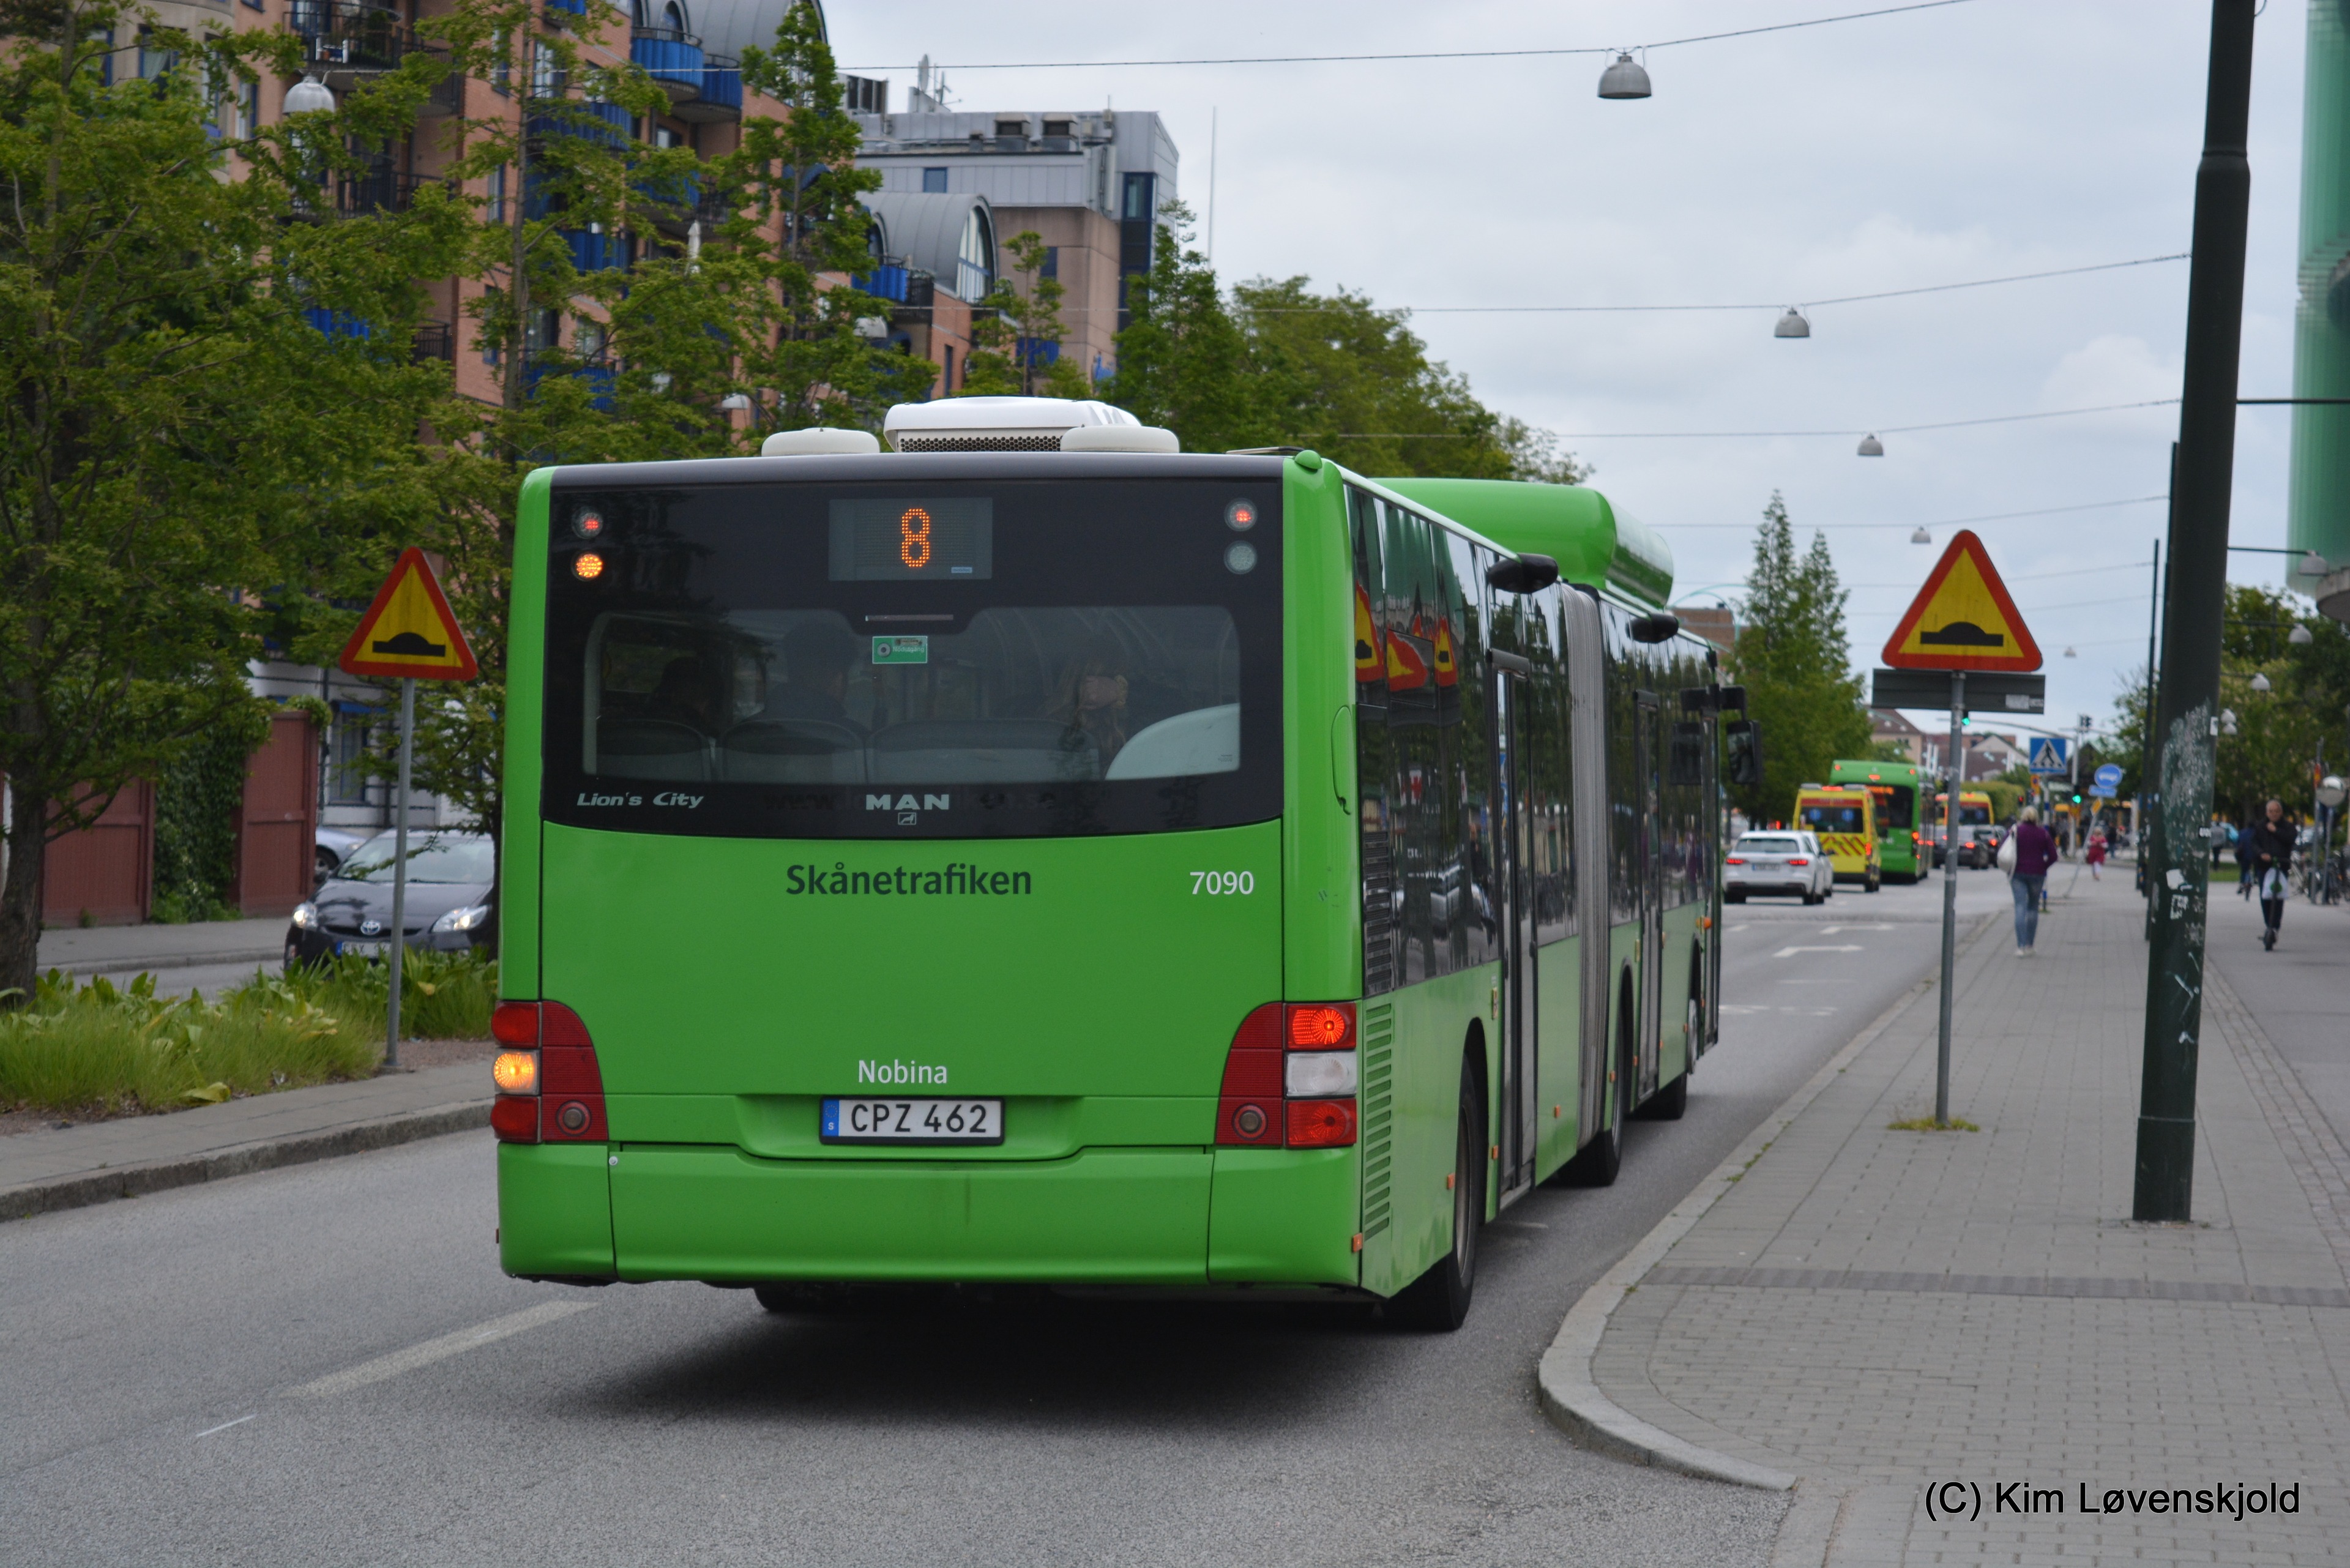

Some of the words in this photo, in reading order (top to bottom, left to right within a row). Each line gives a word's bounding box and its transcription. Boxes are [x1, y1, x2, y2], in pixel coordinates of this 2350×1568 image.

[901, 507, 931, 569] 8
[577, 792, 643, 807] Lion's
[653, 792, 704, 809] City
[866, 794, 950, 811] MAN
[786, 862, 1032, 896] Skånetrafiken
[1190, 871, 1255, 895] 7090
[858, 1059, 949, 1085] Nobina
[827, 1121, 835, 1131] S
[851, 1103, 912, 1133] CPZ
[923, 1103, 988, 1133] 462
